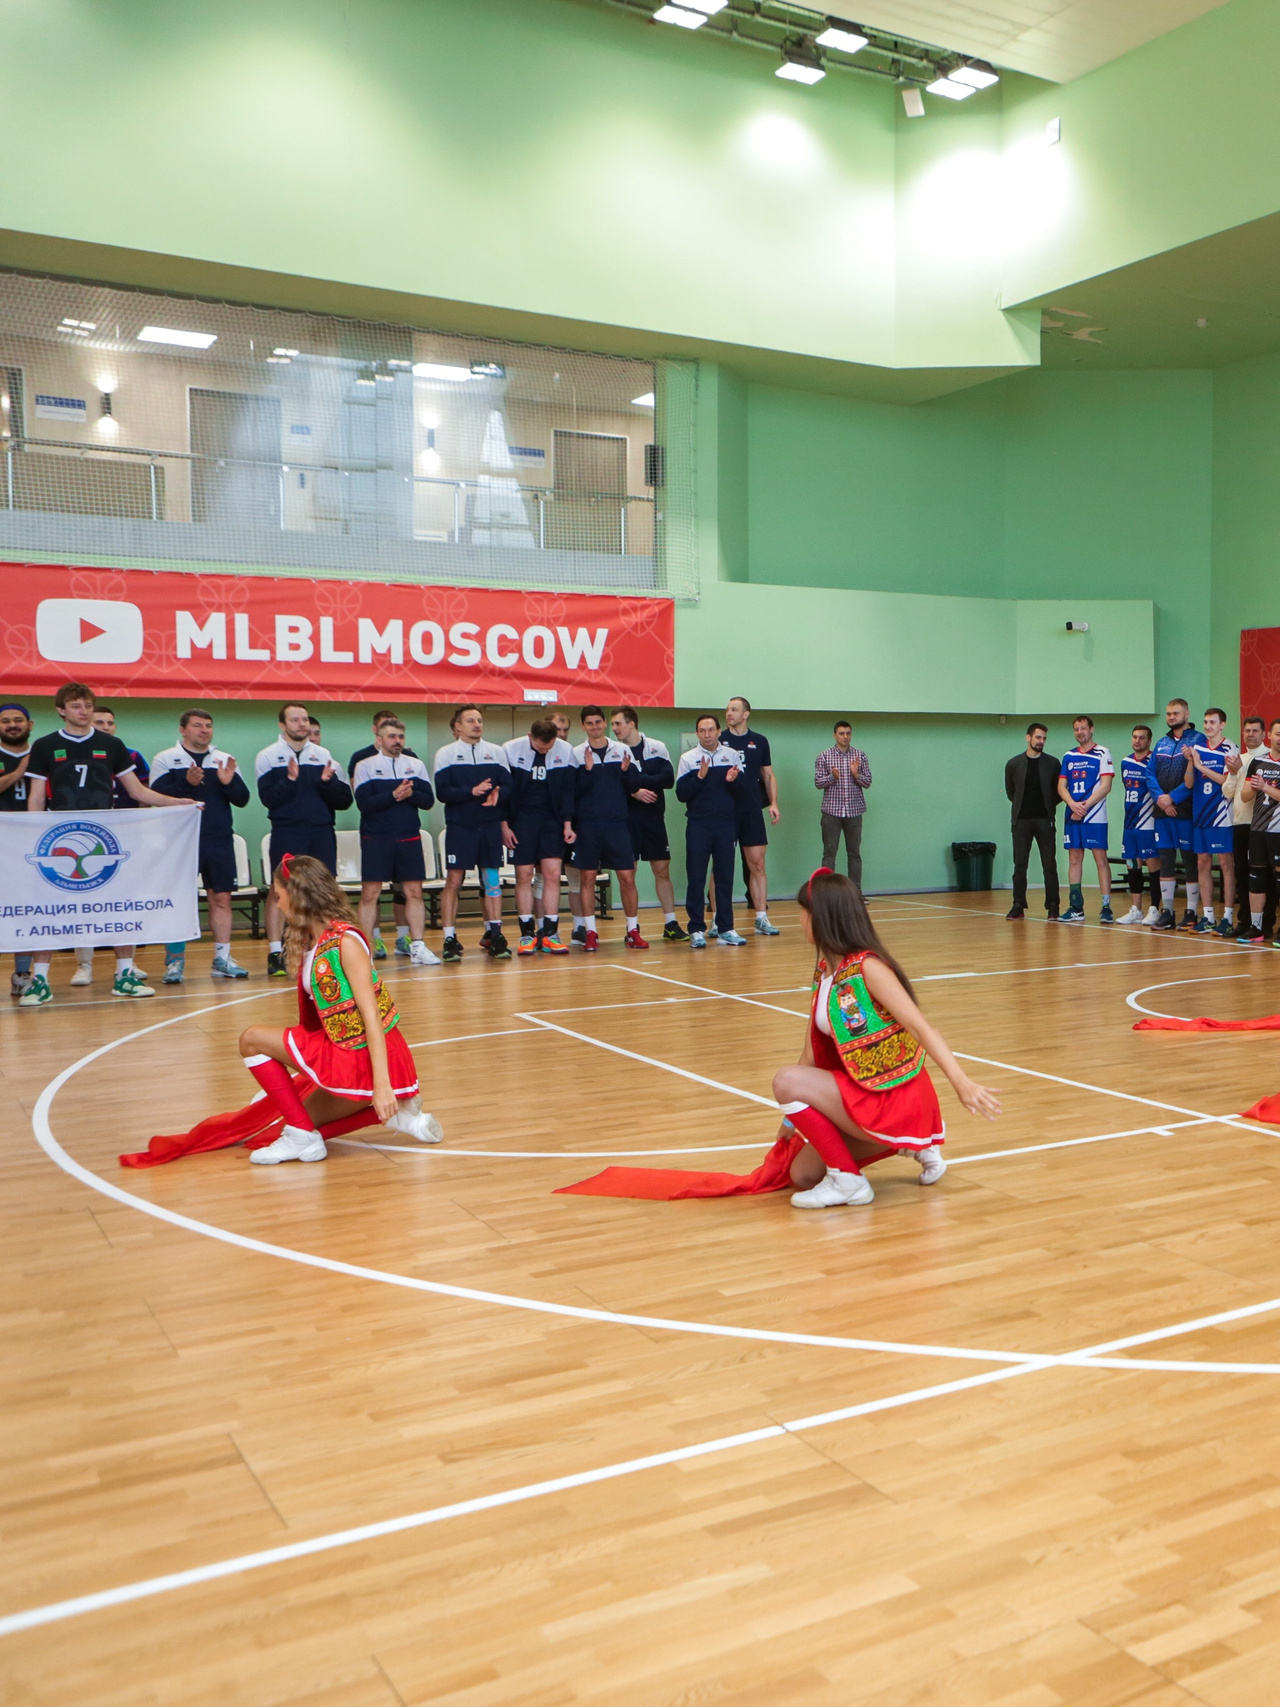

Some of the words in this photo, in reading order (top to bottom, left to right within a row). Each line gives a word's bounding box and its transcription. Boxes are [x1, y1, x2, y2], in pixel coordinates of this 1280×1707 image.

[175, 610, 609, 670] MLBLMOSCOW
[75, 764, 88, 788] 7
[532, 766, 547, 780] 19
[15, 778, 26, 800] 9
[1073, 781, 1086, 794] 11
[1203, 782, 1212, 794] 8
[1126, 790, 1138, 802] 12
[448, 854, 456, 864] 19
[82, 898, 174, 914] ВОЛЕЙБОЛА
[30, 920, 144, 936] АЛЬМЕТЬЕВСК
